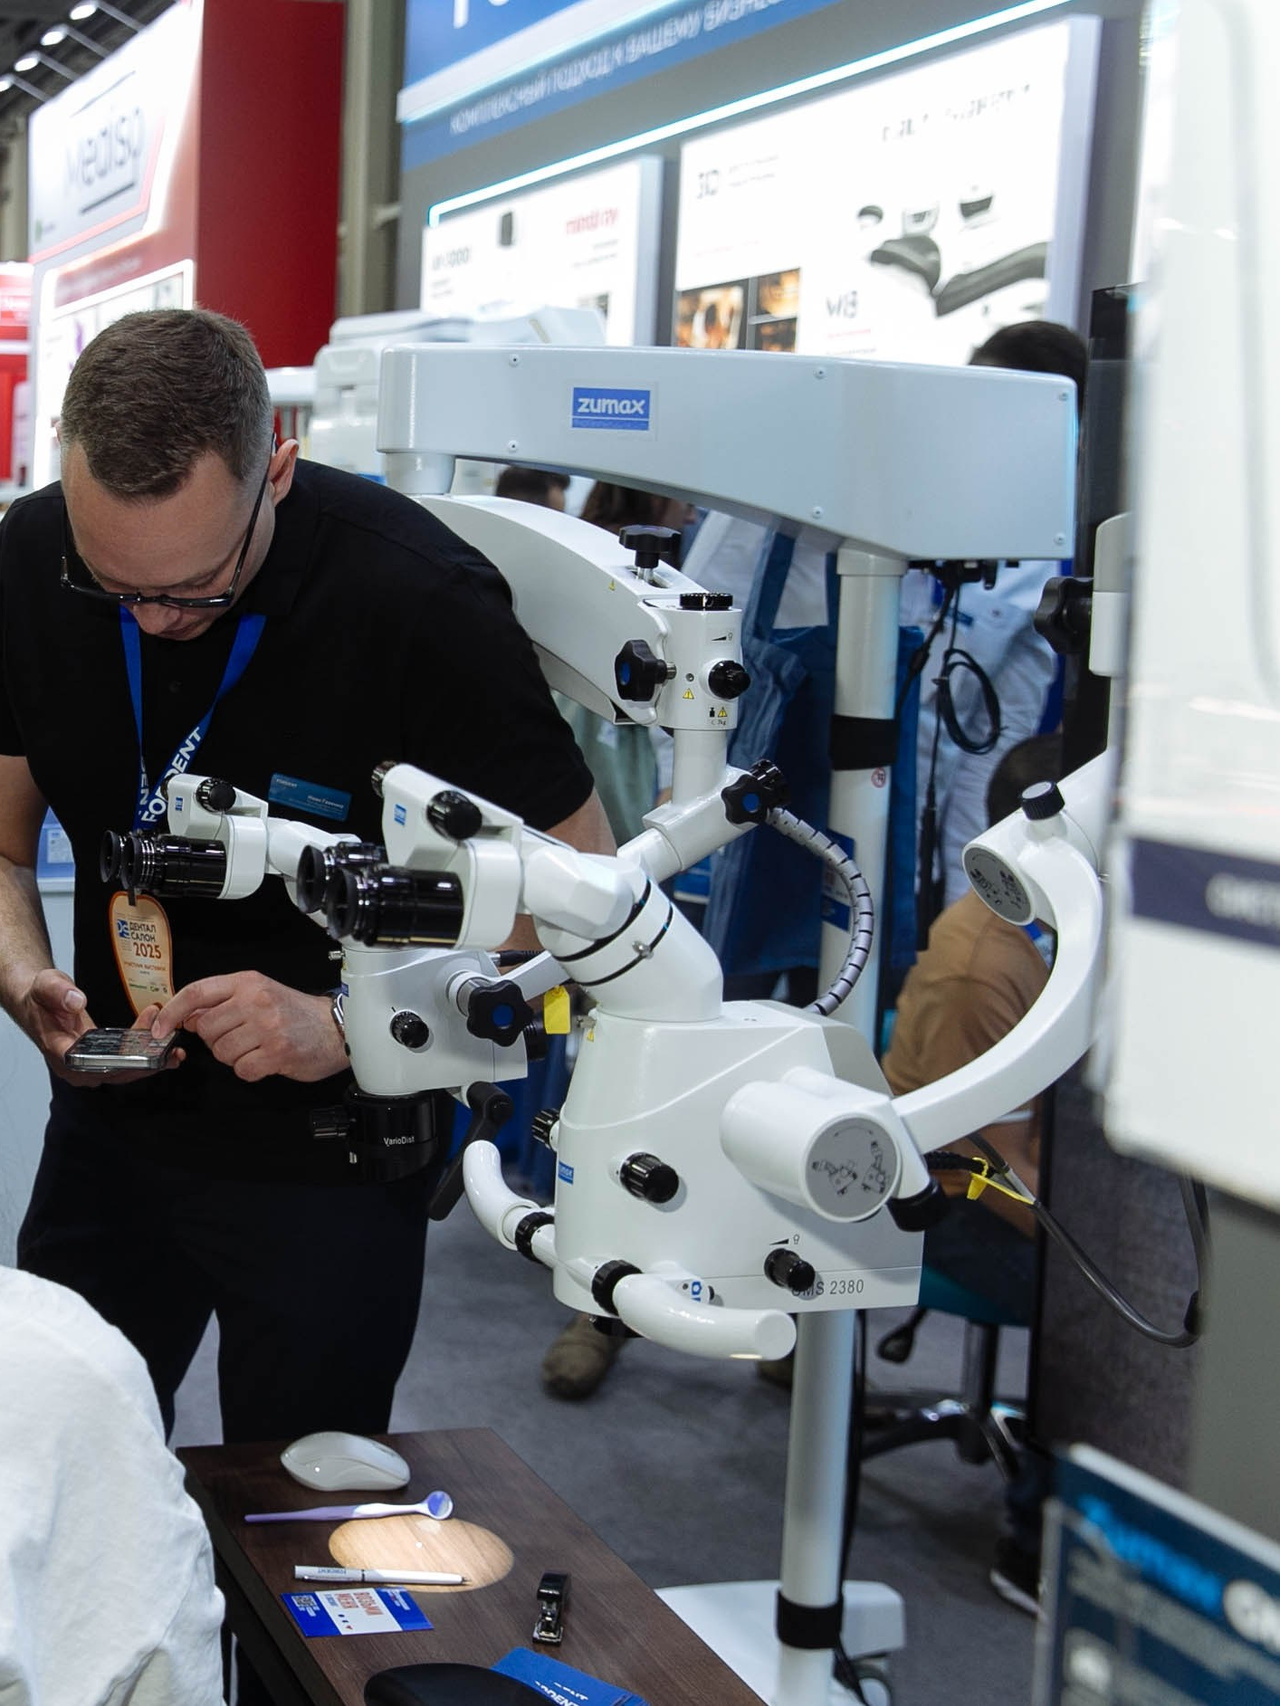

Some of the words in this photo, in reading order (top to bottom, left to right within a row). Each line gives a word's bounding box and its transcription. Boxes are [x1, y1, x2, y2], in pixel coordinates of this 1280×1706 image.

[622, 9, 702, 63] ВАШЕМУ
[577, 398, 646, 415] zumax
[129, 922, 157, 934] ДЕНТАЛ
[131, 932, 156, 943] САЛОН
[133, 942, 162, 960] 2025
[383, 1136, 415, 1146] VarioDist
[830, 1279, 865, 1296] 2380
